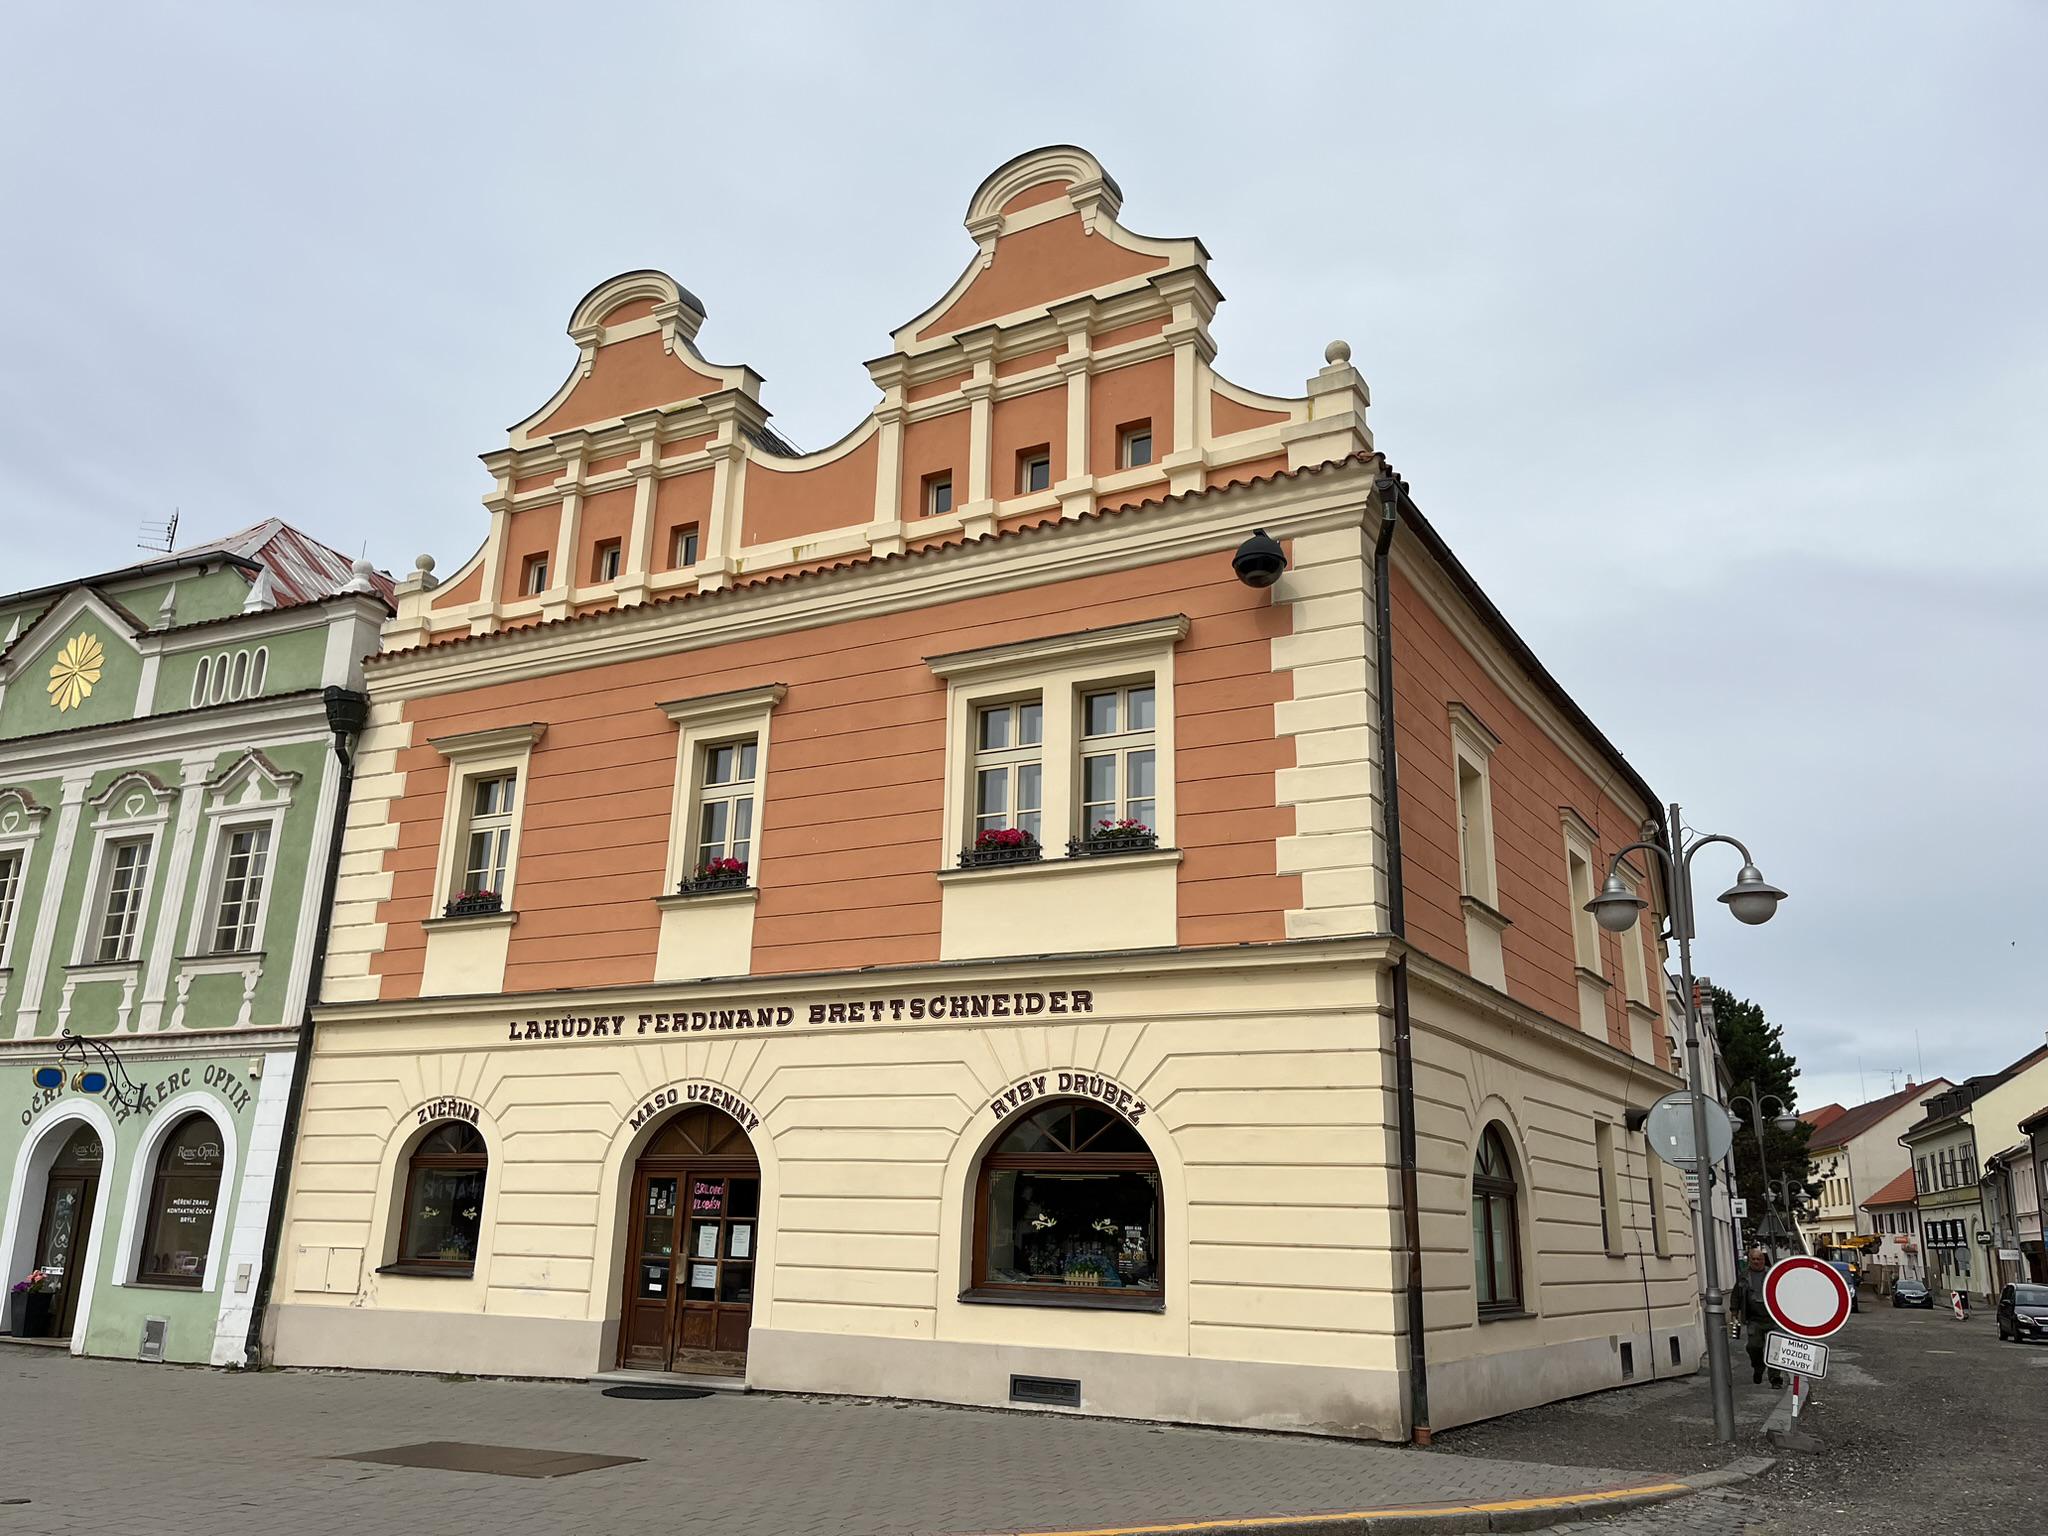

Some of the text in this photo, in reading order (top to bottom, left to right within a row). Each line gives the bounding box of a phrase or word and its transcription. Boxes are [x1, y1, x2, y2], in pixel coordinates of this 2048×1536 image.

[509, 990, 1094, 1041] LAHŮDKY FERDINAND BRETTSCHNEIDER
[203, 1064, 251, 1114] OPTIK
[990, 1073, 1147, 1126] RYBY DRŮBEŽ
[417, 1098, 480, 1127] ZVĚŘINA
[629, 1084, 760, 1133] MASO UZENINY
[197, 1142, 220, 1160] Optik
[1781, 1347, 1812, 1361] VOZIDEL
[1788, 1340, 1809, 1350] MIMO
[1781, 1357, 1810, 1370] STAVBY
